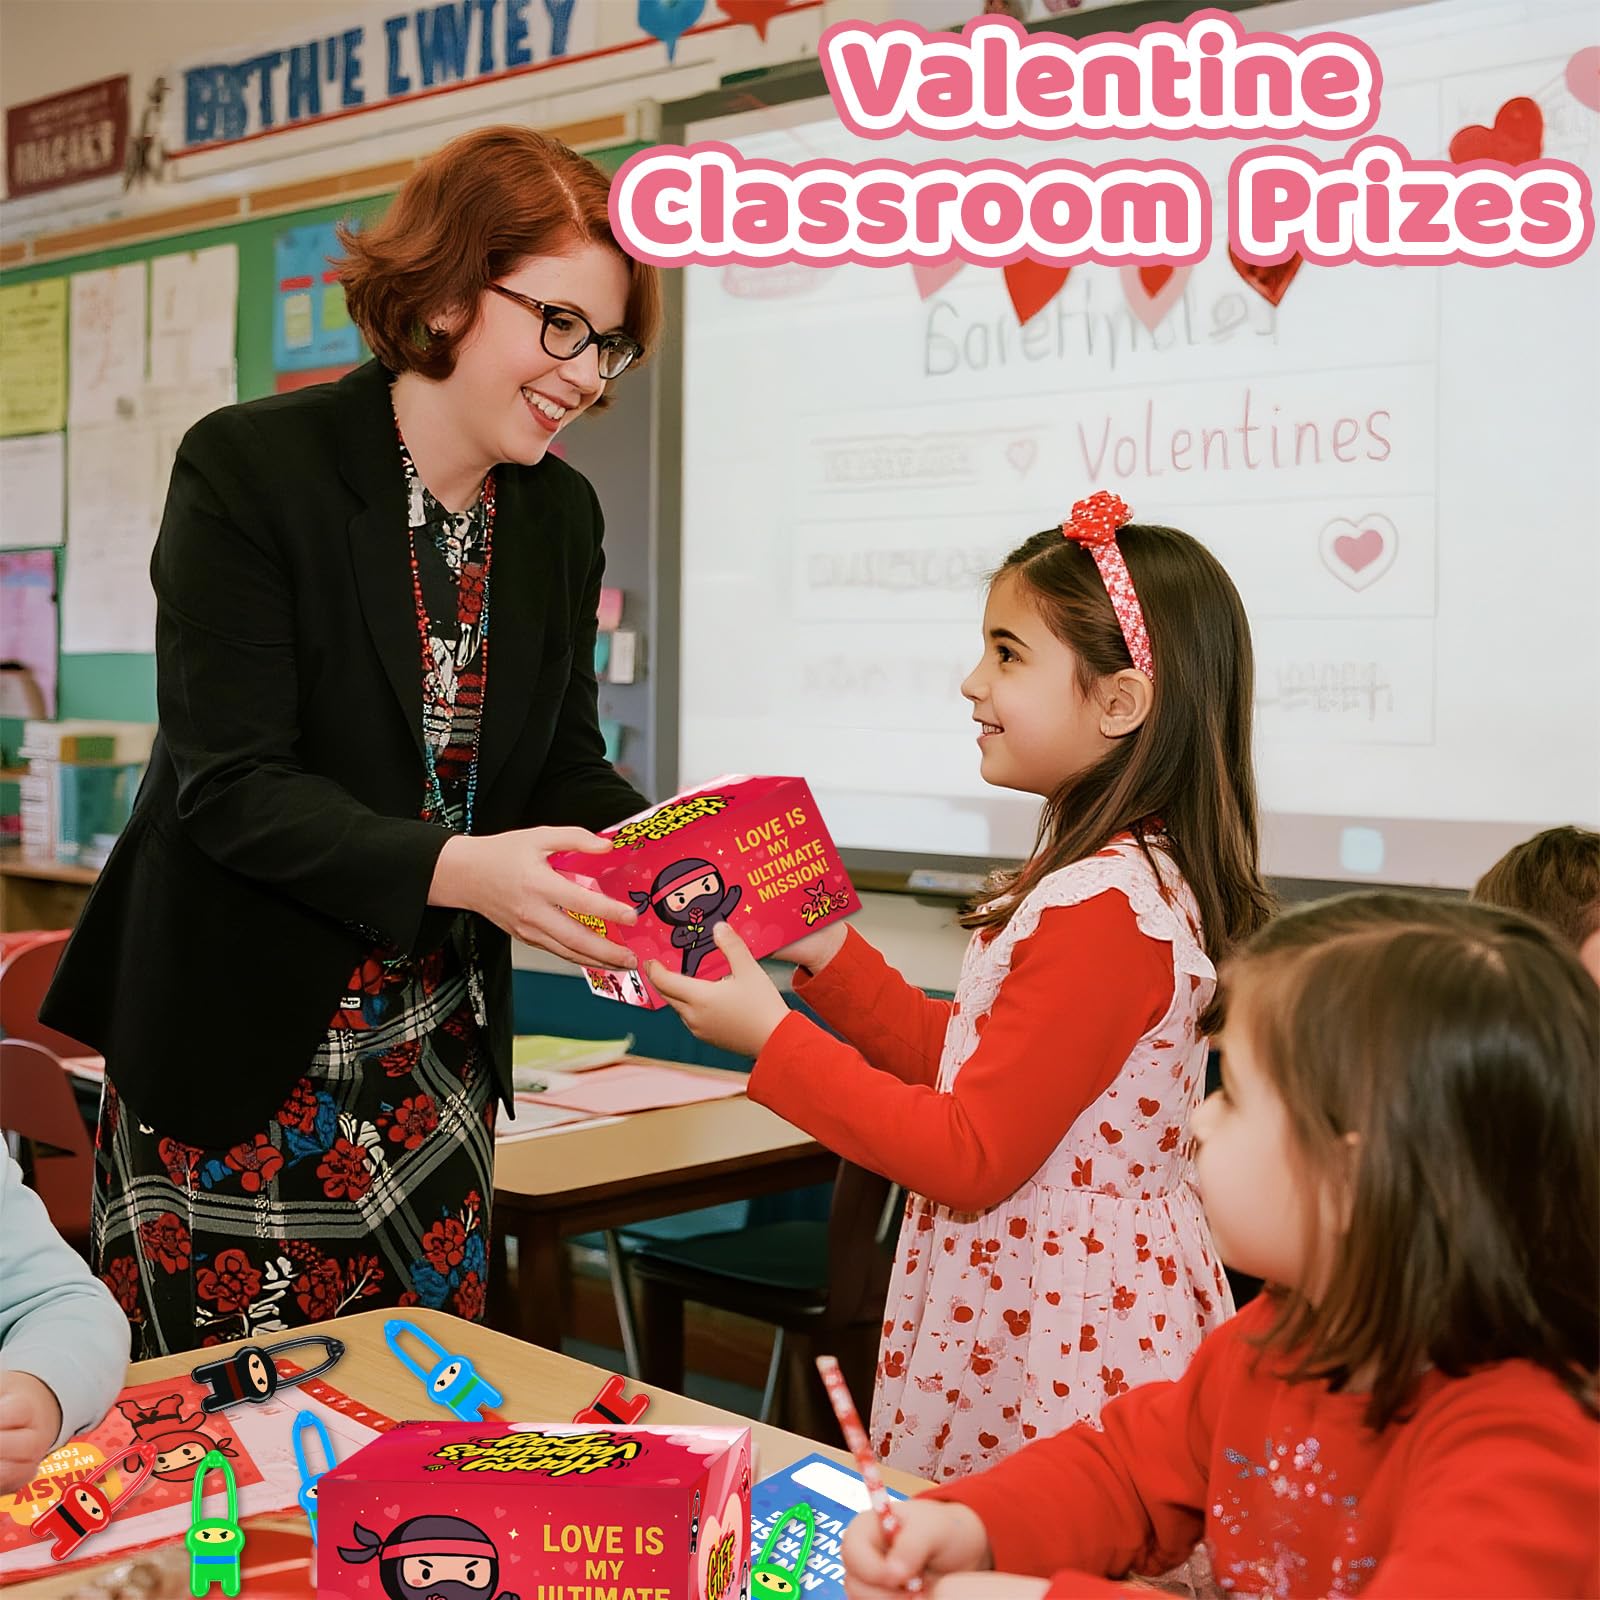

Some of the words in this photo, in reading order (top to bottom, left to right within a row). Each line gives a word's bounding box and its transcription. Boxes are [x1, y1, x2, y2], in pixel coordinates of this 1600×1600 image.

[735, 817, 785, 853] LOVE
[785, 807, 806, 829] IS
[766, 836, 790, 857] MY
[747, 839, 825, 886] ULTIMATE
[757, 857, 830, 903] MISSION!
[480, 1432, 613, 1448] Day
[52, 1447, 80, 1460] FOR
[74, 1455, 95, 1467] MY
[459, 1456, 612, 1477] Happy
[543, 1524, 624, 1554] LOVE
[635, 1526, 664, 1556] IS
[585, 1559, 625, 1580] MY
